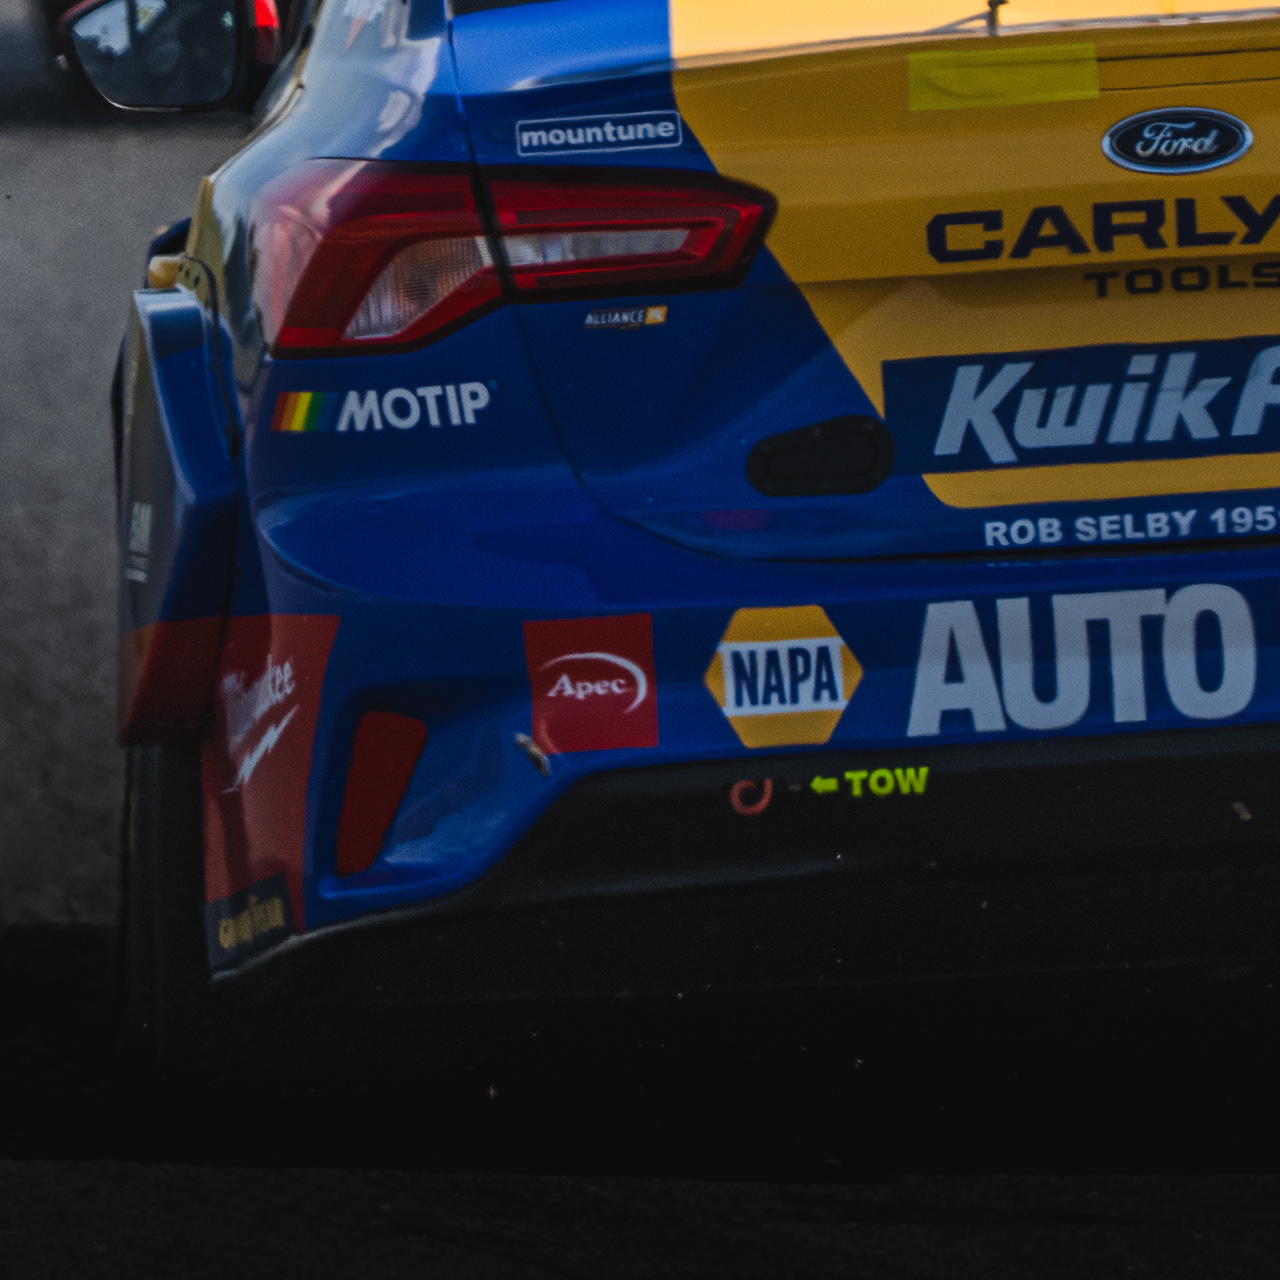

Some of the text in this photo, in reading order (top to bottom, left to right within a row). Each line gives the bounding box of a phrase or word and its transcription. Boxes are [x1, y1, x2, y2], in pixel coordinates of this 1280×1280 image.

[521, 118, 676, 148] mountune
[1134, 121, 1220, 158] Ford
[335, 381, 492, 433] MOTIP
[933, 350, 1233, 464] Kwik
[984, 518, 1063, 548] ROB
[1075, 509, 1197, 542] SELBY
[729, 645, 841, 709] NAPA
[906, 582, 1257, 738] AUTO
[546, 671, 628, 700] Apec
[844, 765, 929, 797] TOW
